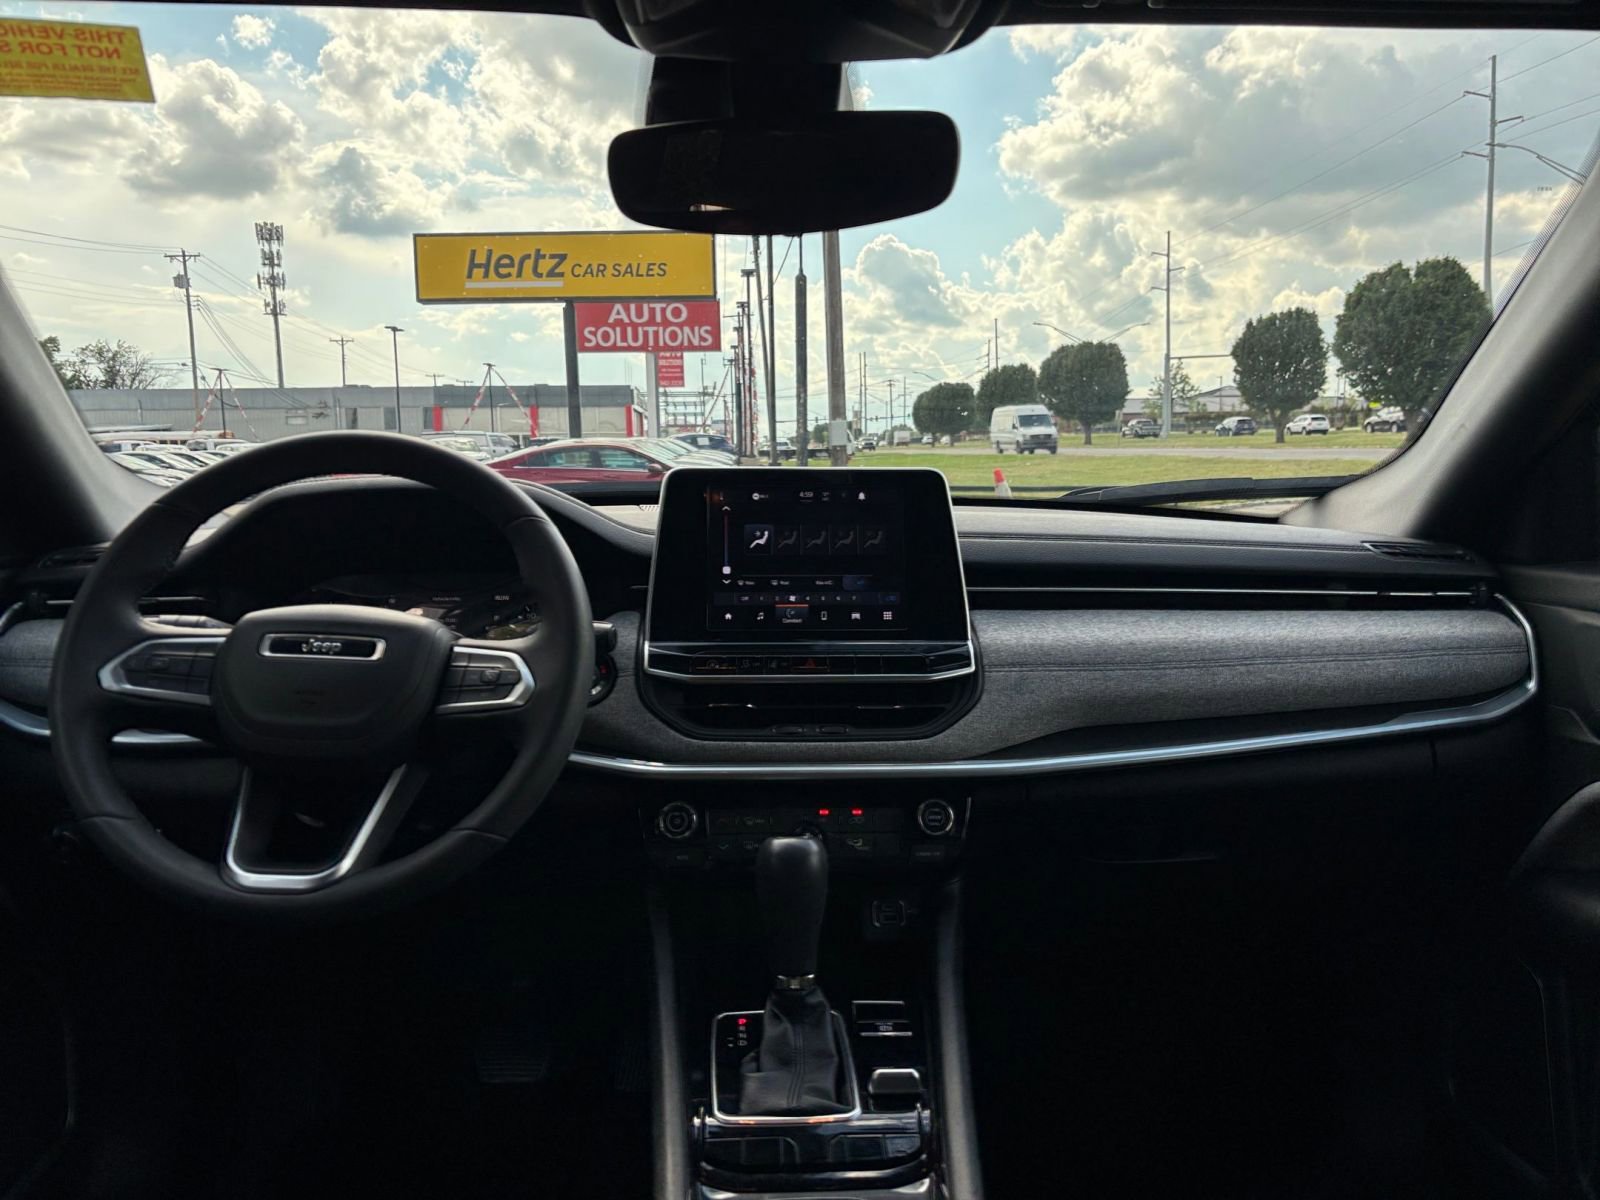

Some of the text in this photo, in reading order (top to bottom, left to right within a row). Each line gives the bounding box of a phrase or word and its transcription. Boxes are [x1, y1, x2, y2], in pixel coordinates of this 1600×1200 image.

[466, 248, 668, 279] Hertz CAR SALES
[607, 302, 688, 324] AUTO
[583, 325, 713, 348] SOLUTIONS
[301, 638, 342, 655] Jeep
